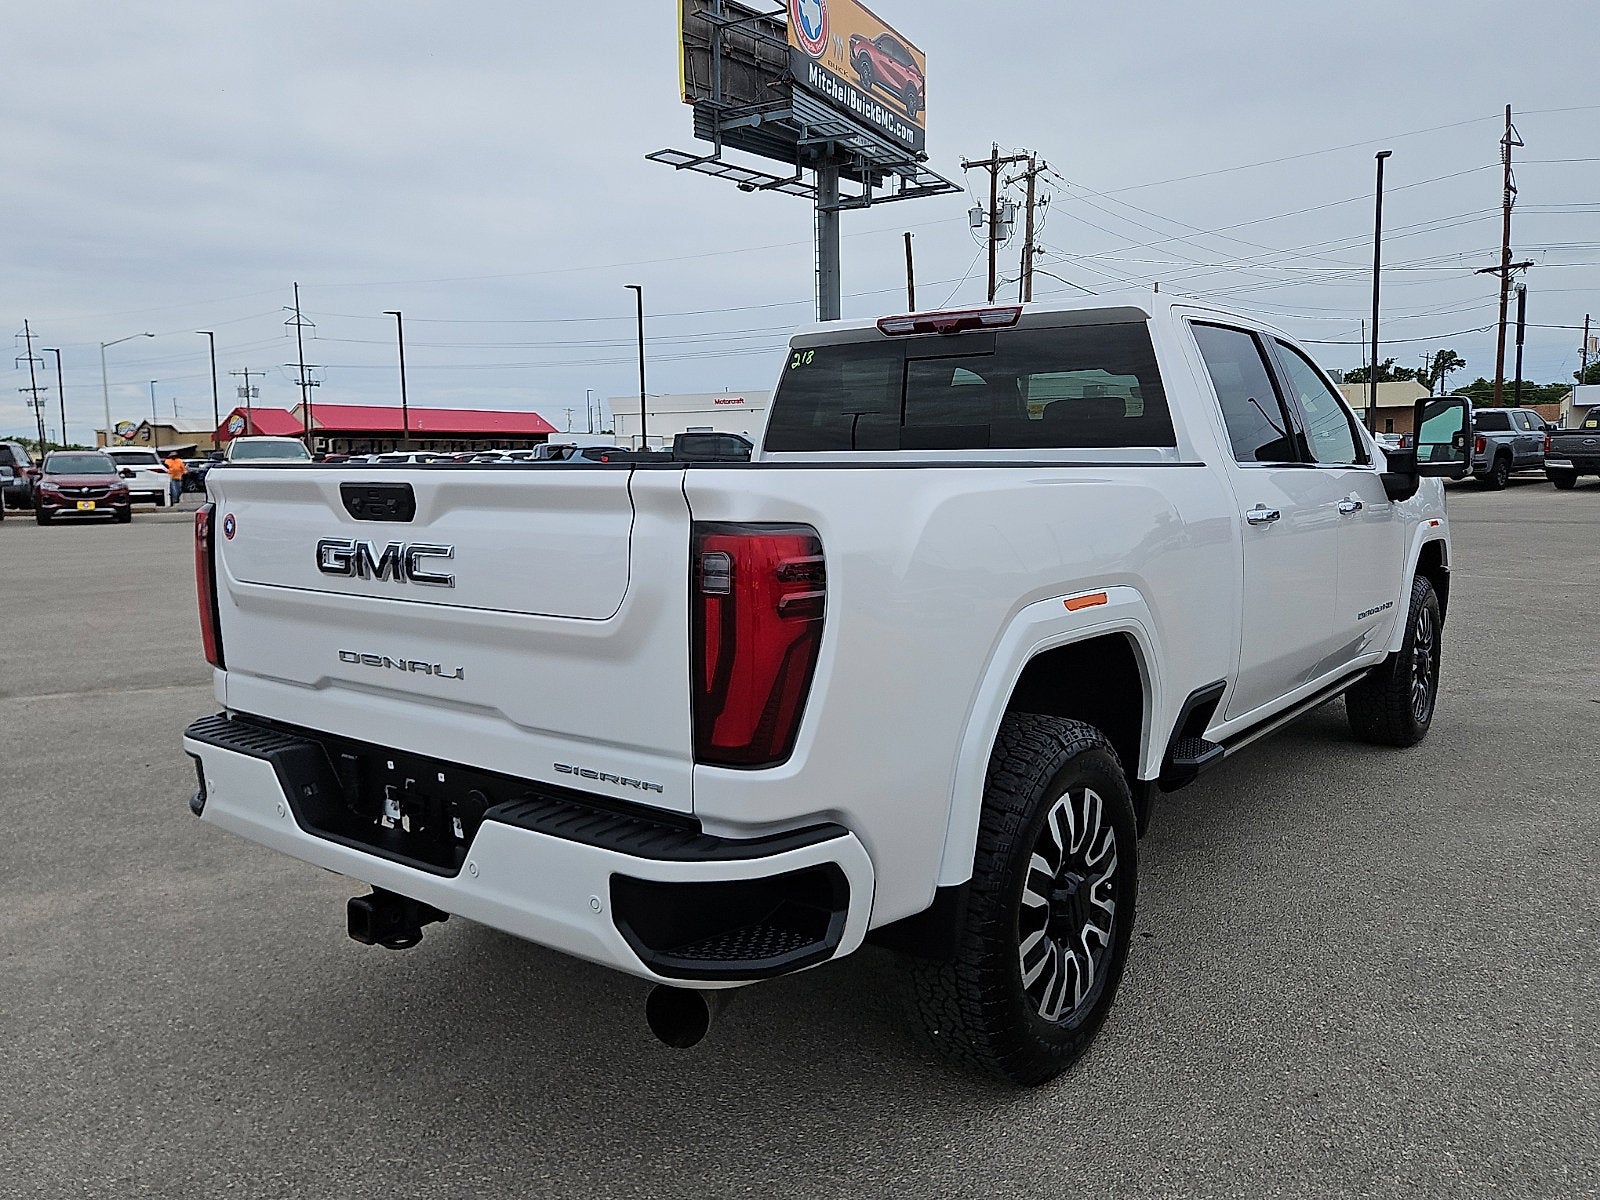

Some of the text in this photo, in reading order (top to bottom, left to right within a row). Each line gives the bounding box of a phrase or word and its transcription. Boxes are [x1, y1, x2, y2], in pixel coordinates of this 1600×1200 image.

[809, 62, 914, 144] MitchellBuickGMC.com
[791, 350, 815, 369] 218
[714, 397, 745, 405] Motorcraft
[316, 537, 456, 588] GMC
[338, 650, 465, 681] DENALI
[553, 762, 664, 793] SIERRA
